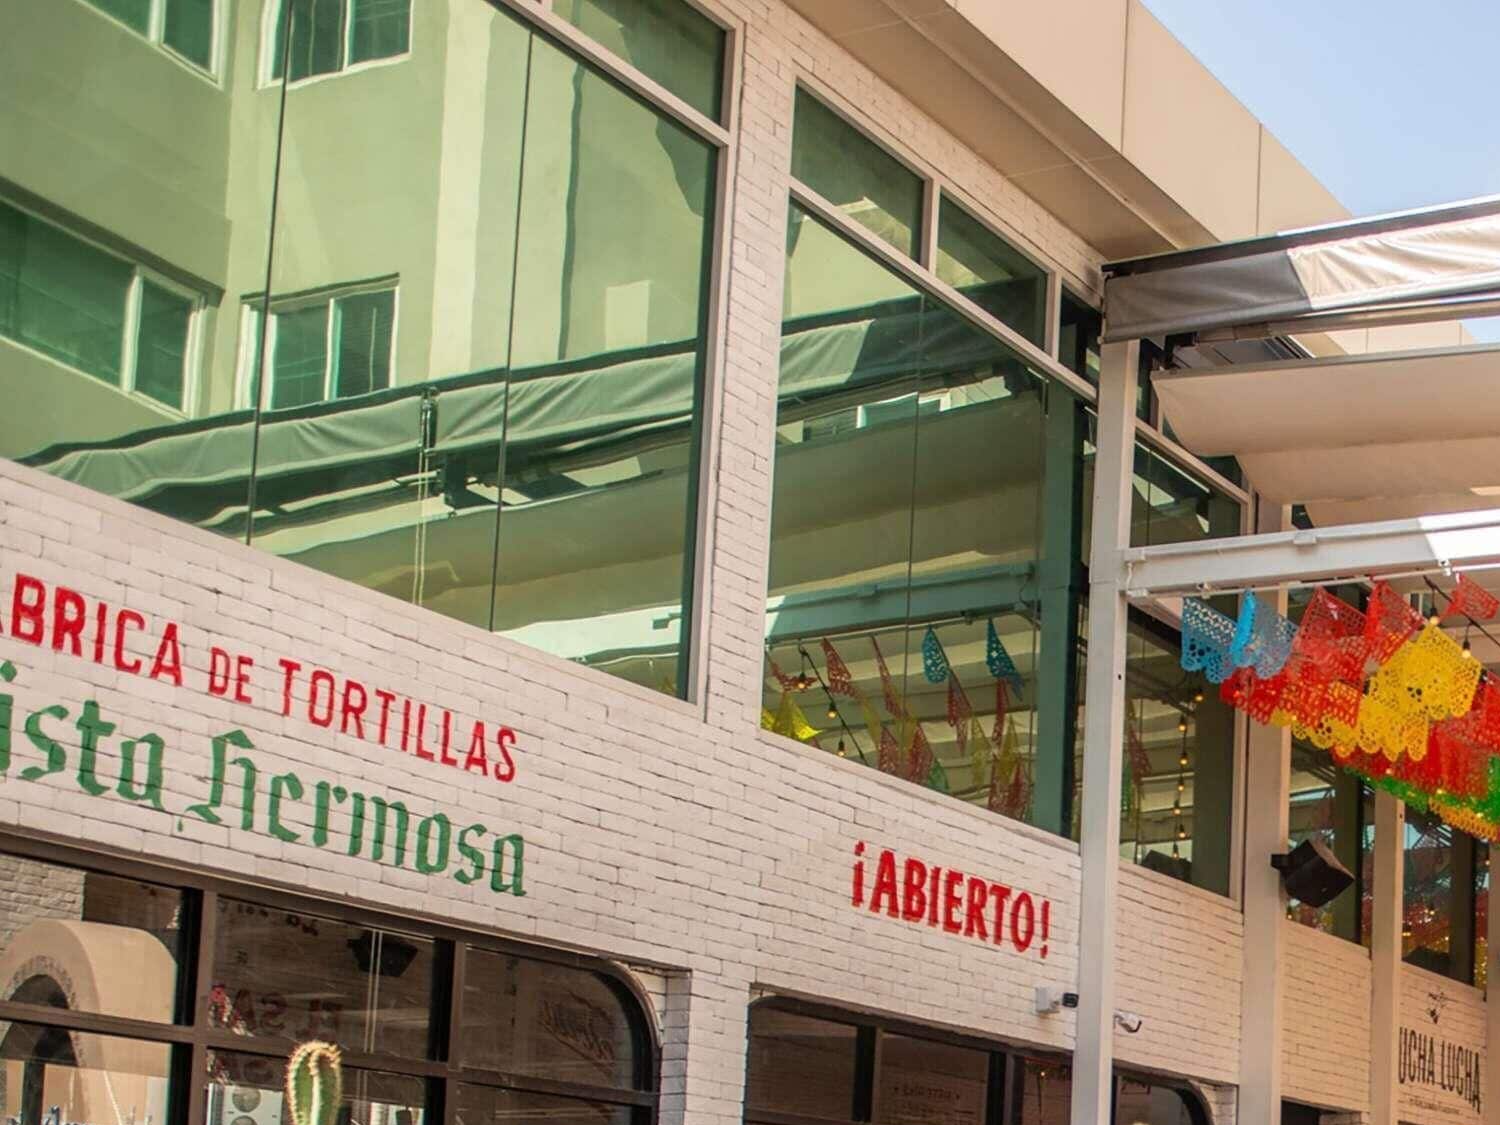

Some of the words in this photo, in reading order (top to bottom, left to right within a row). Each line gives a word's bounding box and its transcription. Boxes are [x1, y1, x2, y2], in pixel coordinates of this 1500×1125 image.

[0, 571, 186, 688] BRICA
[207, 644, 255, 706] DE
[277, 656, 519, 784] TORTILLAS
[177, 727, 528, 898] Hermosa
[851, 840, 1051, 959] ¡ABIERTO!
[1397, 1026, 1436, 1087] UCHA
[1441, 1039, 1482, 1115] LUCHA
